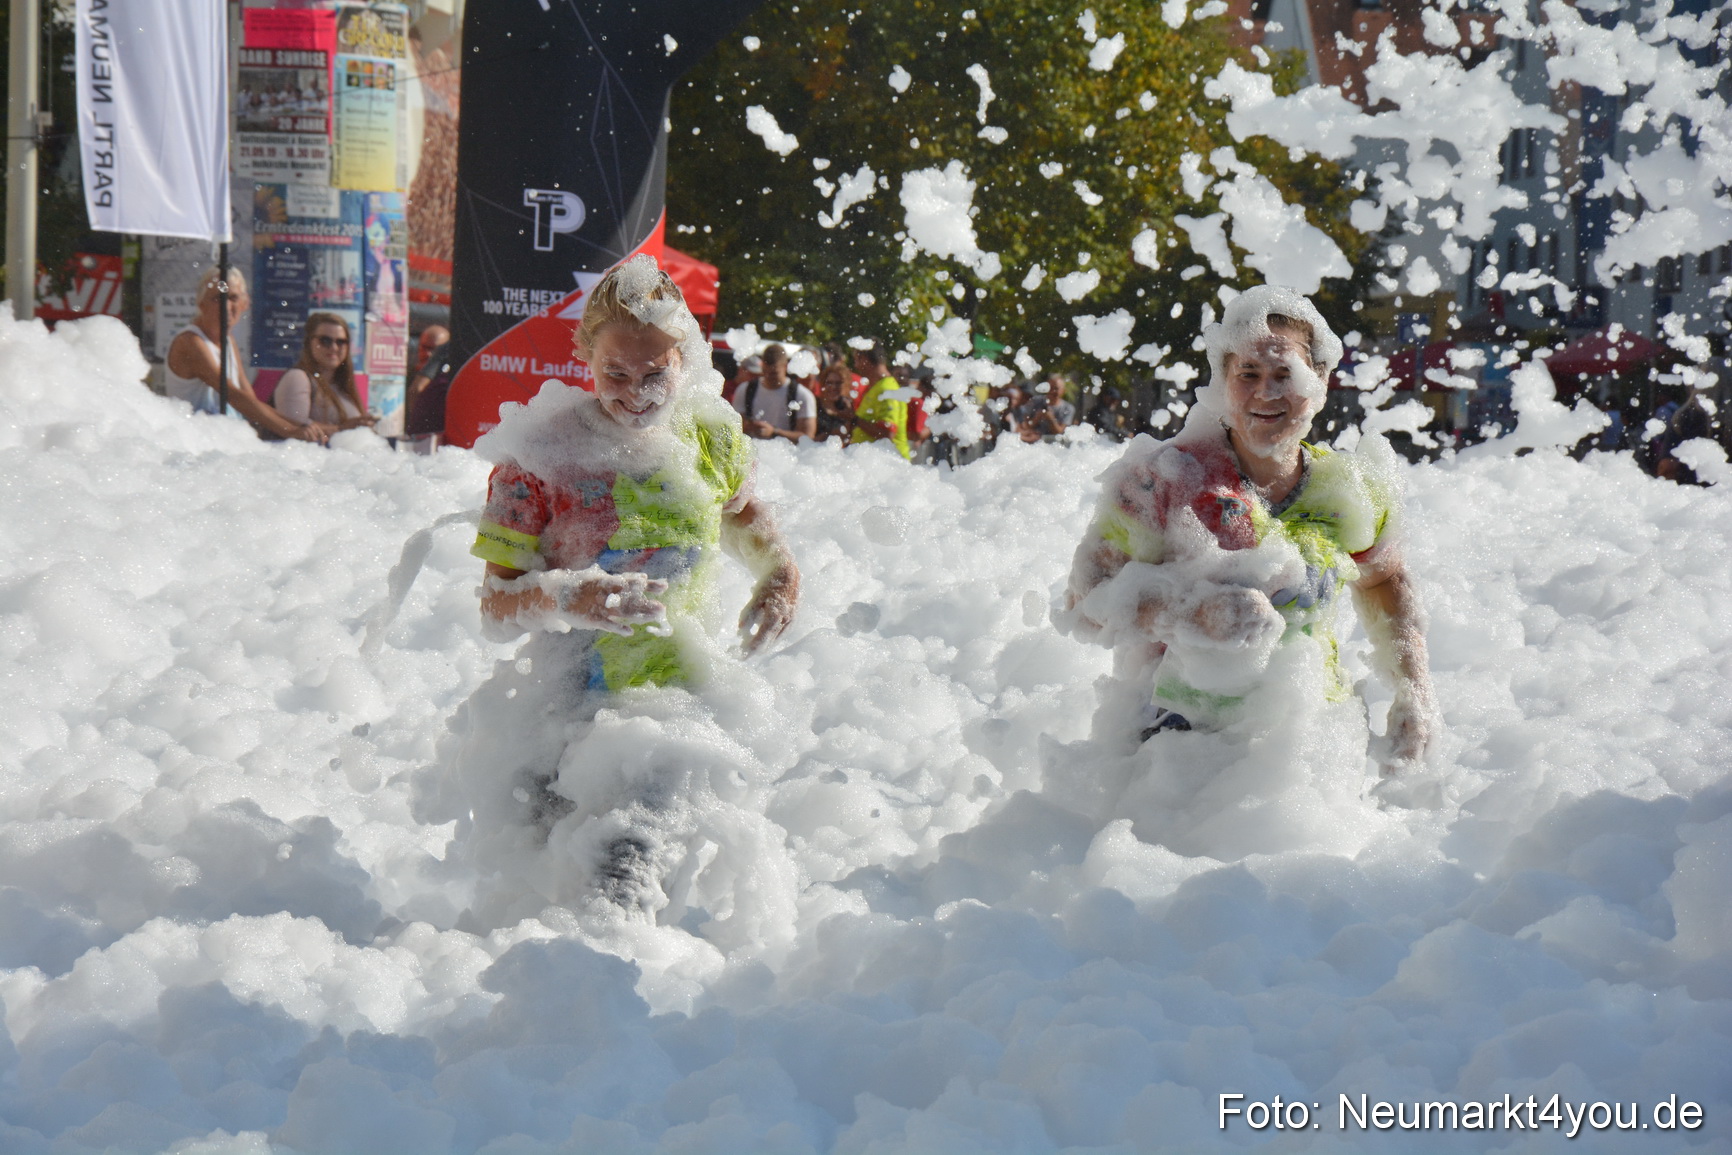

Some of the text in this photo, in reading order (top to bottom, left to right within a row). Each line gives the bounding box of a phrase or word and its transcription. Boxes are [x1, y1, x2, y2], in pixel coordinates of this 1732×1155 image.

[502, 287, 567, 305] THE NEXT
[482, 300, 549, 318] 100 YEARS
[480, 354, 527, 374] BMW
